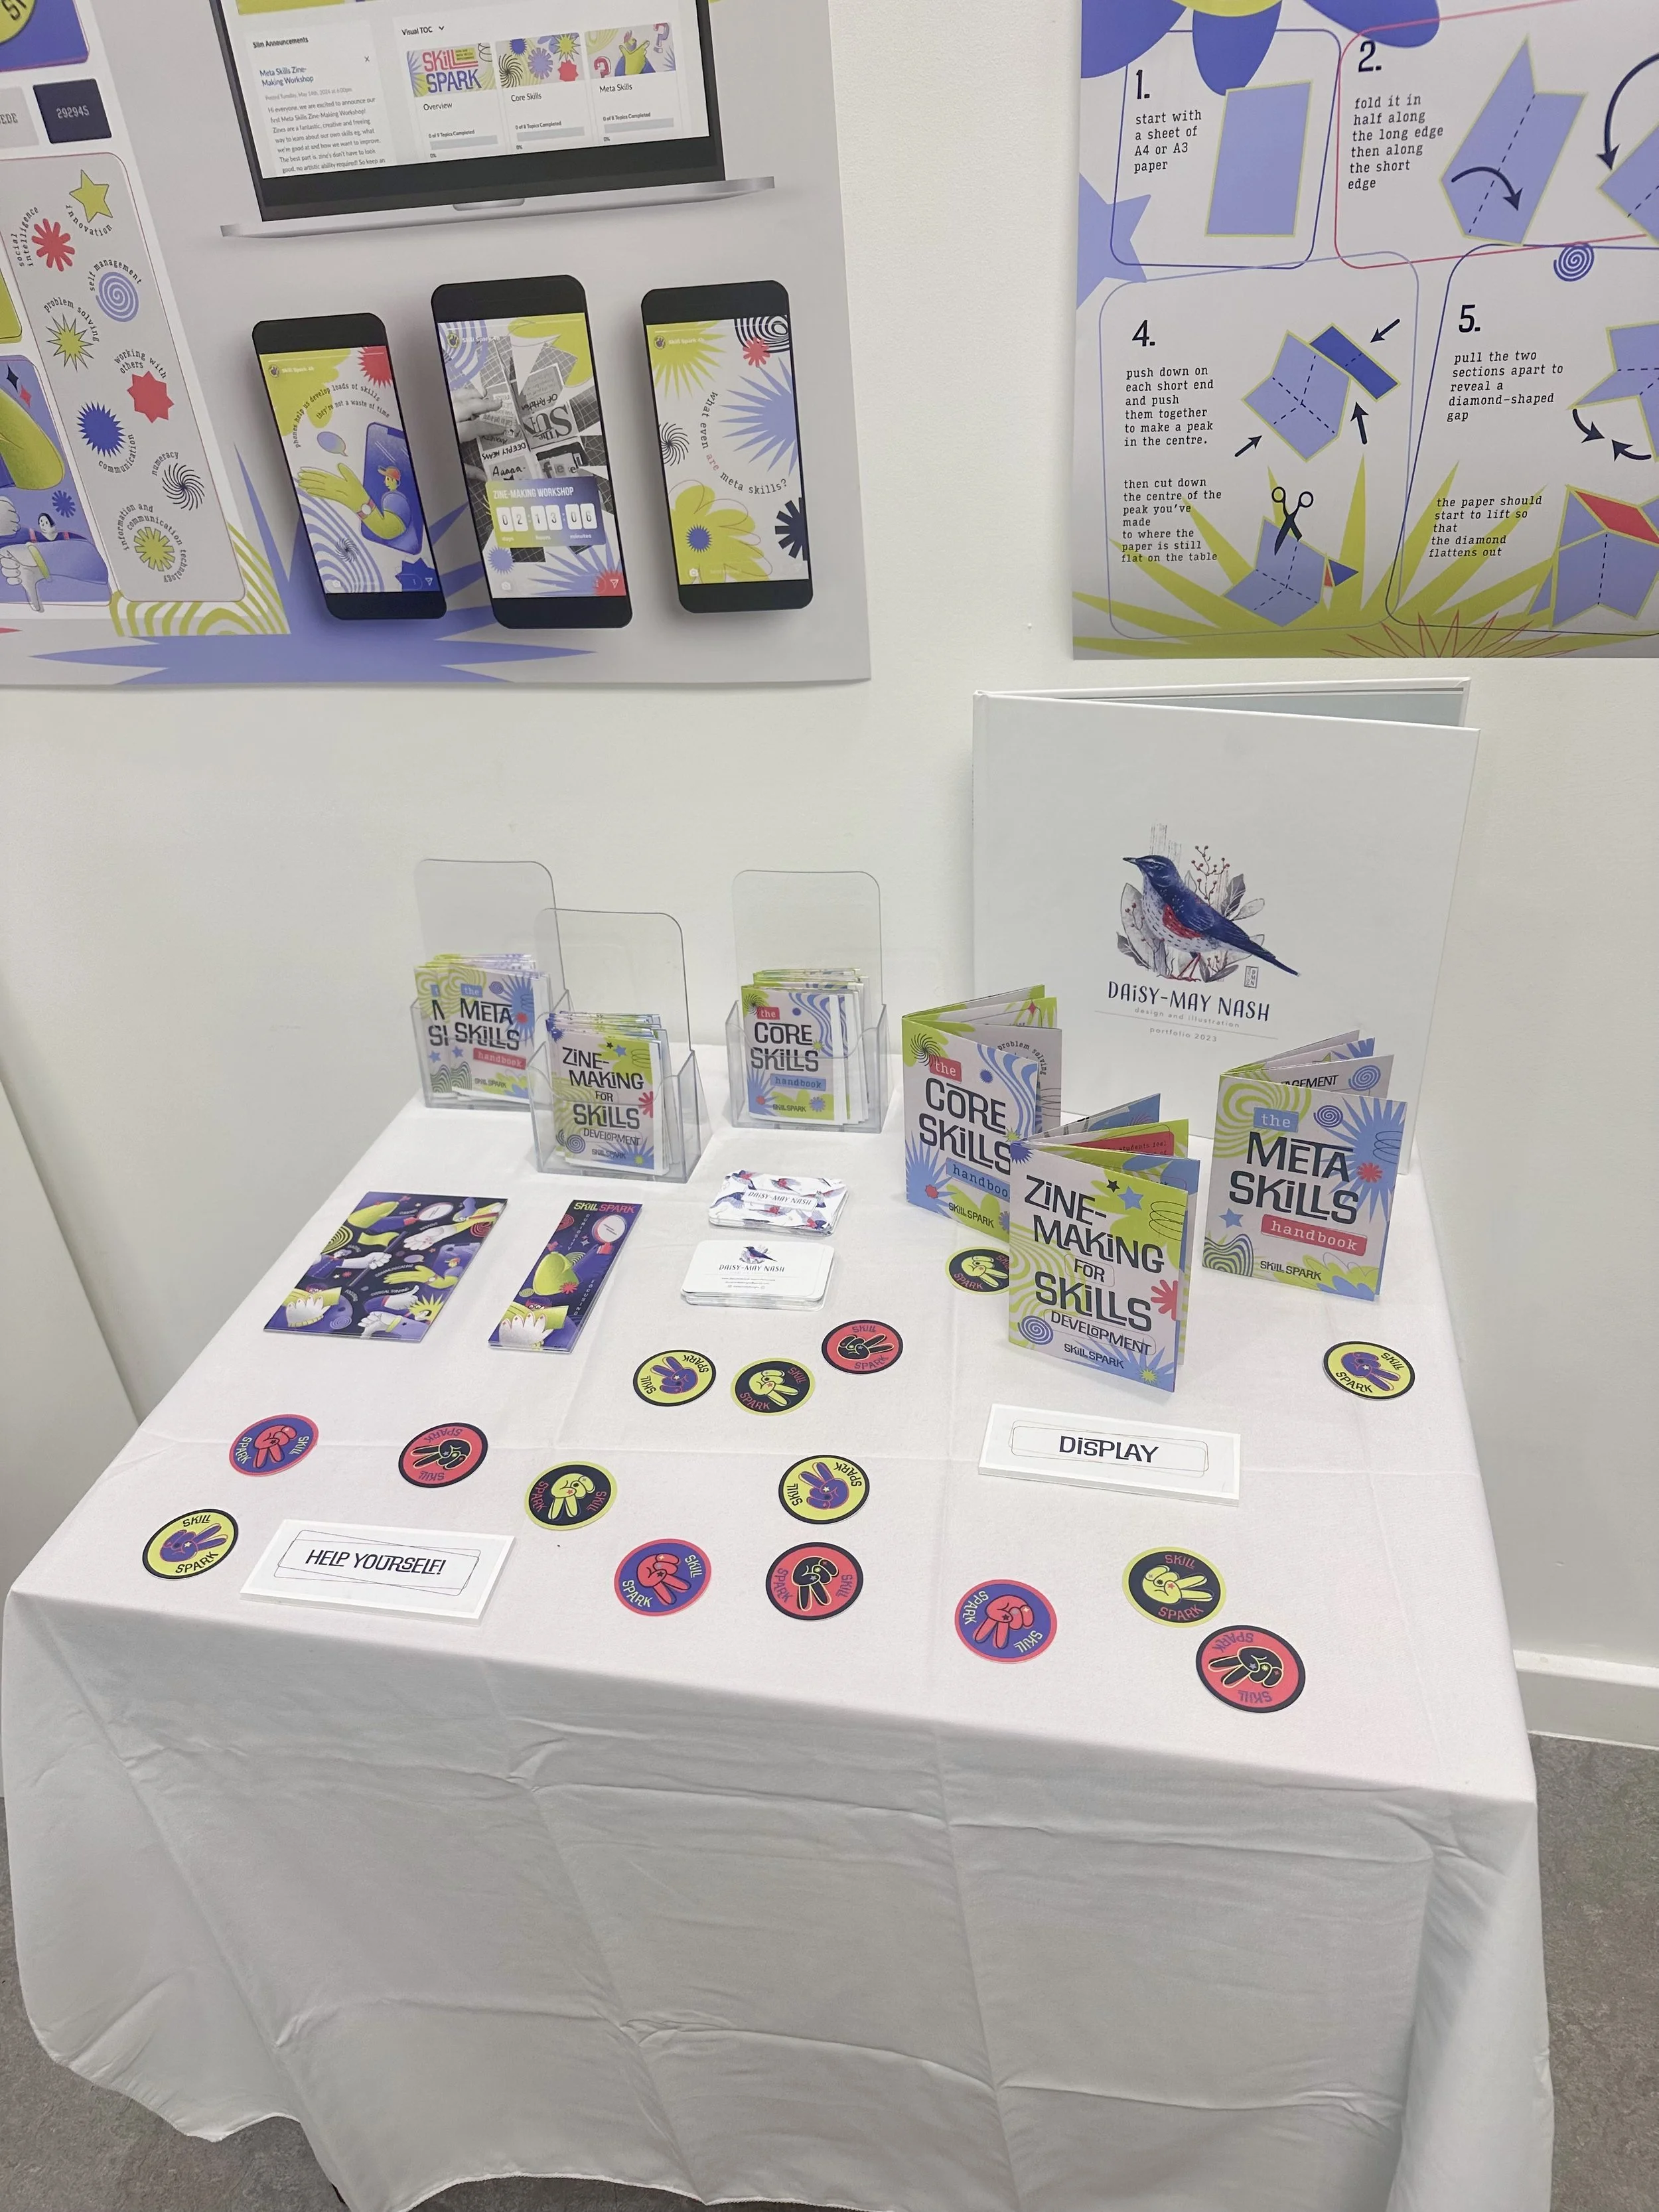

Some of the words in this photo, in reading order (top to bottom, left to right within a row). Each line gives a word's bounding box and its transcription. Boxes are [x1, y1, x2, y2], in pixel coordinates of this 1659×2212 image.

[265, 37, 309, 47] Announcements
[1357, 40, 1382, 73] 2.
[261, 78, 283, 87] Making
[284, 76, 314, 85] Workshop
[425, 69, 482, 93] SPARK
[1135, 69, 1151, 100] 1.
[423, 102, 453, 111] Overview
[1354, 96, 1382, 110] fold
[1388, 94, 1401, 108] it
[1407, 93, 1421, 106] in
[56, 105, 90, 119] 292945
[1135, 113, 1168, 125] start
[1173, 110, 1202, 123] with
[1353, 113, 1384, 126] half
[1389, 110, 1426, 125] along
[1135, 131, 1142, 141] a
[1147, 127, 1182, 140] sheet
[1185, 125, 1198, 137] of
[1352, 129, 1374, 143] the
[1378, 127, 1408, 143] long
[1413, 125, 1444, 139] edge
[1134, 143, 1150, 157] A4
[1155, 144, 1167, 156] or
[1173, 141, 1189, 155] A3
[1351, 145, 1380, 158] then
[1386, 142, 1423, 159] along
[1133, 159, 1168, 175] paper
[1349, 161, 1373, 174] the
[1376, 159, 1411, 173] short
[1347, 177, 1376, 193] edge
[66, 204, 113, 236] innovation
[19, 206, 38, 267] intelligence
[11, 234, 25, 267] social
[94, 259, 142, 284] management
[43, 297, 74, 313] problem
[77, 307, 100, 342] solving
[1458, 305, 1482, 333] 5.
[1131, 319, 1156, 347] 4.
[114, 348, 146, 364] working
[149, 357, 167, 378] with
[1453, 352, 1483, 365] pull
[1488, 351, 1509, 362] the
[1514, 350, 1538, 361] two
[120, 361, 143, 374] others
[1125, 368, 1154, 380] push
[1159, 366, 1189, 377] down
[1194, 366, 1208, 376] on
[1451, 365, 1506, 378] sections
[1511, 364, 1547, 377] apart
[1551, 363, 1564, 374] to
[360, 386, 380, 402] skills
[1125, 382, 1153, 393] each
[1157, 380, 1189, 392] short
[1193, 378, 1214, 390] end
[1450, 380, 1492, 393] reveal
[1496, 382, 1504, 391] a
[310, 387, 331, 402] develop
[1124, 396, 1147, 406] and
[1151, 395, 1180, 407] push
[1448, 393, 1555, 407] diamond-shaped
[303, 401, 310, 409] us
[316, 404, 334, 419] they're
[377, 406, 390, 418] time
[701, 391, 718, 417] what
[294, 409, 305, 423] help
[1124, 408, 1154, 419] them
[1158, 408, 1208, 421] together
[1447, 411, 1469, 423] gap
[699, 421, 709, 449] even
[1124, 423, 1136, 433] to
[1139, 421, 1171, 433] make
[1185, 421, 1214, 433] peak
[293, 424, 301, 448] phones
[1124, 436, 1138, 447] in
[1141, 435, 1161, 445] the
[1165, 435, 1208, 445] centre.
[98, 434, 136, 473] communication
[705, 453, 719, 471] are
[152, 451, 179, 476] numeracy
[720, 471, 744, 492] meta
[748, 479, 787, 495] skills?
[493, 488, 536, 499] ZINE-MAKING
[538, 487, 574, 497] WORKSHOP
[118, 504, 136, 550] information
[139, 503, 153, 513] and
[127, 515, 183, 546] communication
[164, 549, 188, 583] technology
[463, 986, 480, 995] the
[460, 998, 512, 1025] META
[760, 1008, 776, 1018] the
[1135, 1007, 1164, 1017] design
[1188, 1014, 1240, 1028] illustration
[1218, 997, 1269, 1021] NASH
[754, 1022, 813, 1045] CORE
[1149, 1027, 1190, 1039] portfolio
[1194, 1033, 1217, 1042] 2023
[476, 1051, 523, 1067] handbook
[997, 1041, 1030, 1051] problem
[1032, 1049, 1047, 1076] solving
[934, 1061, 956, 1076] the
[775, 1076, 822, 1088] handbook
[595, 1091, 613, 1102] FOR
[926, 1078, 1006, 1135] CORE
[1261, 1114, 1291, 1128] the
[583, 1128, 640, 1146] DEVELOPMENT
[1246, 1132, 1354, 1183] META
[952, 1164, 1010, 1199] handboo
[1271, 1220, 1358, 1251] handbook
[1074, 1258, 1105, 1283] FOR
[1051, 1311, 1151, 1356] DEVELOPMENT
[682, 1354, 709, 1373] SPARK
[853, 1356, 889, 1369] SPARK
[1336, 1371, 1373, 1392] SPARK
[739, 1392, 770, 1410] SPARK
[175, 1550, 219, 1575] SPARK
[305, 1549, 350, 1568] HELP
[354, 1554, 446, 1576] YOURSELF!
[1157, 1605, 1205, 1621] SPARK
